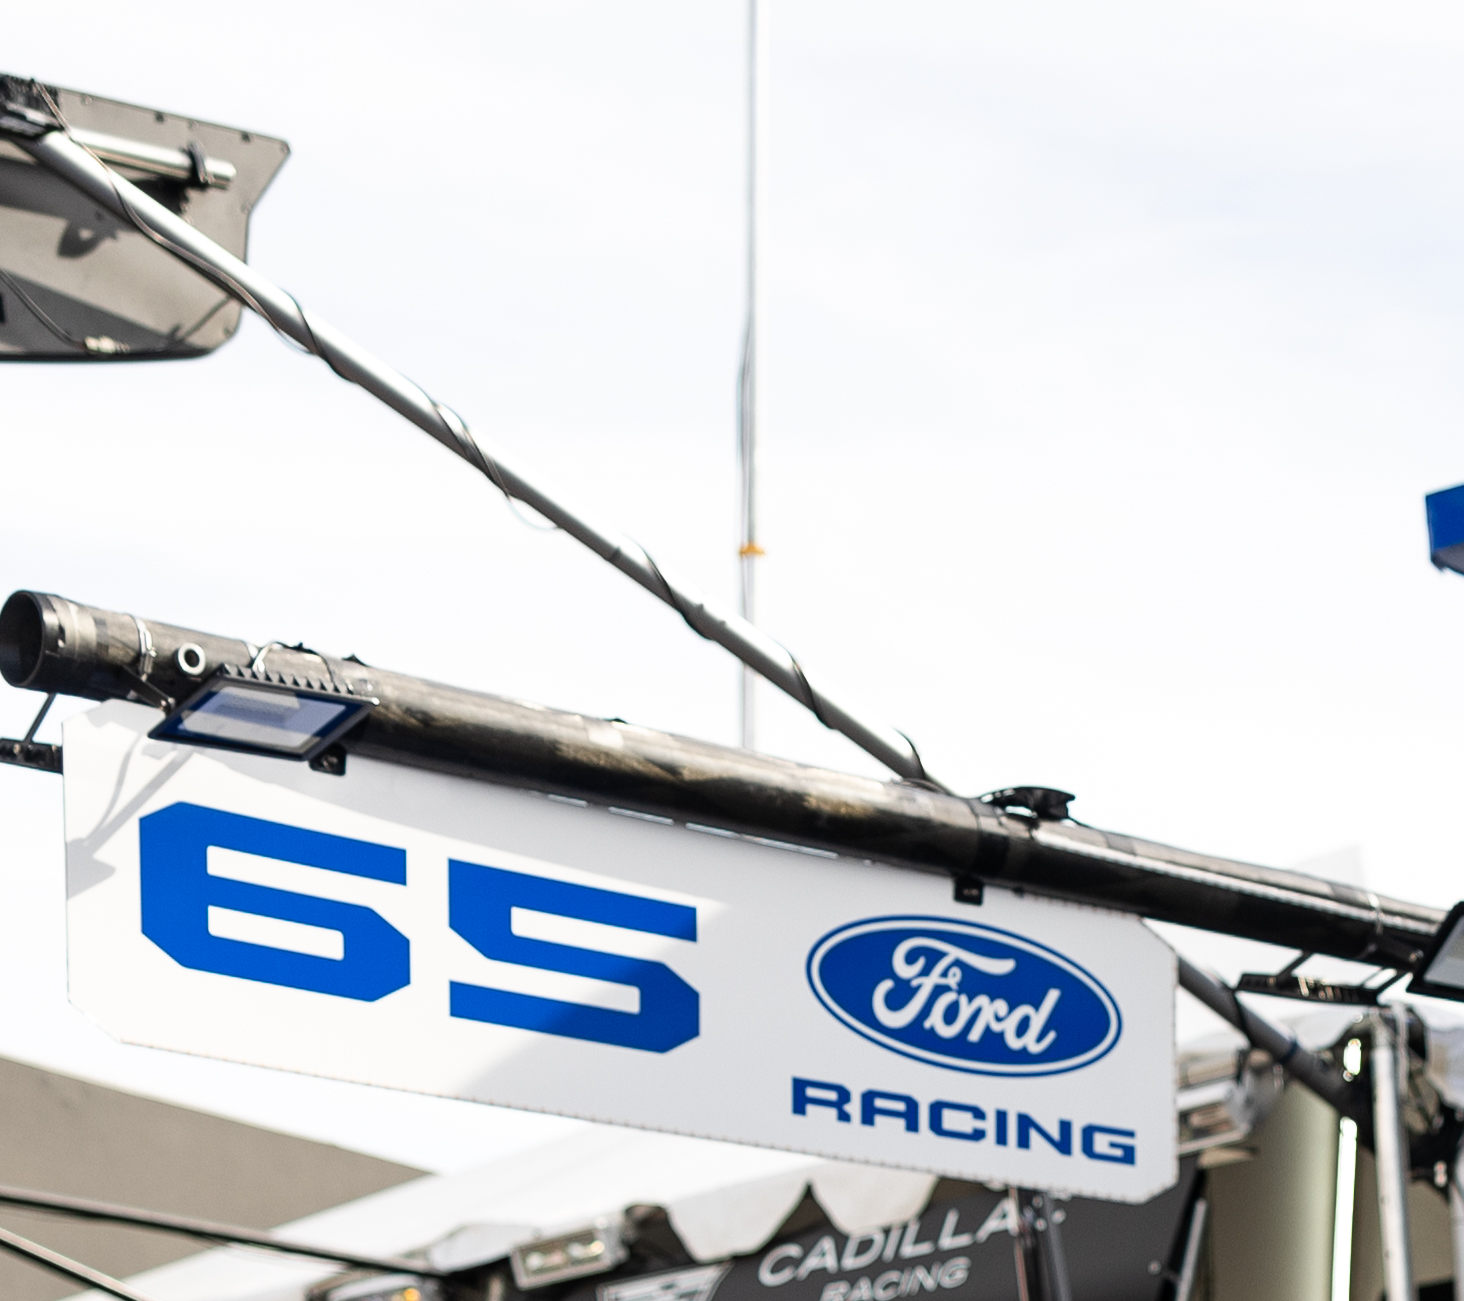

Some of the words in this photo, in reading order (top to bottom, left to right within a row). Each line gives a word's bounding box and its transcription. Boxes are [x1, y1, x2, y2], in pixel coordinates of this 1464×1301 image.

[138, 800, 701, 1054] 65
[871, 932, 1061, 1058] Ford
[790, 1075, 1137, 1167] RACING
[756, 1199, 1066, 1290] CADILLA
